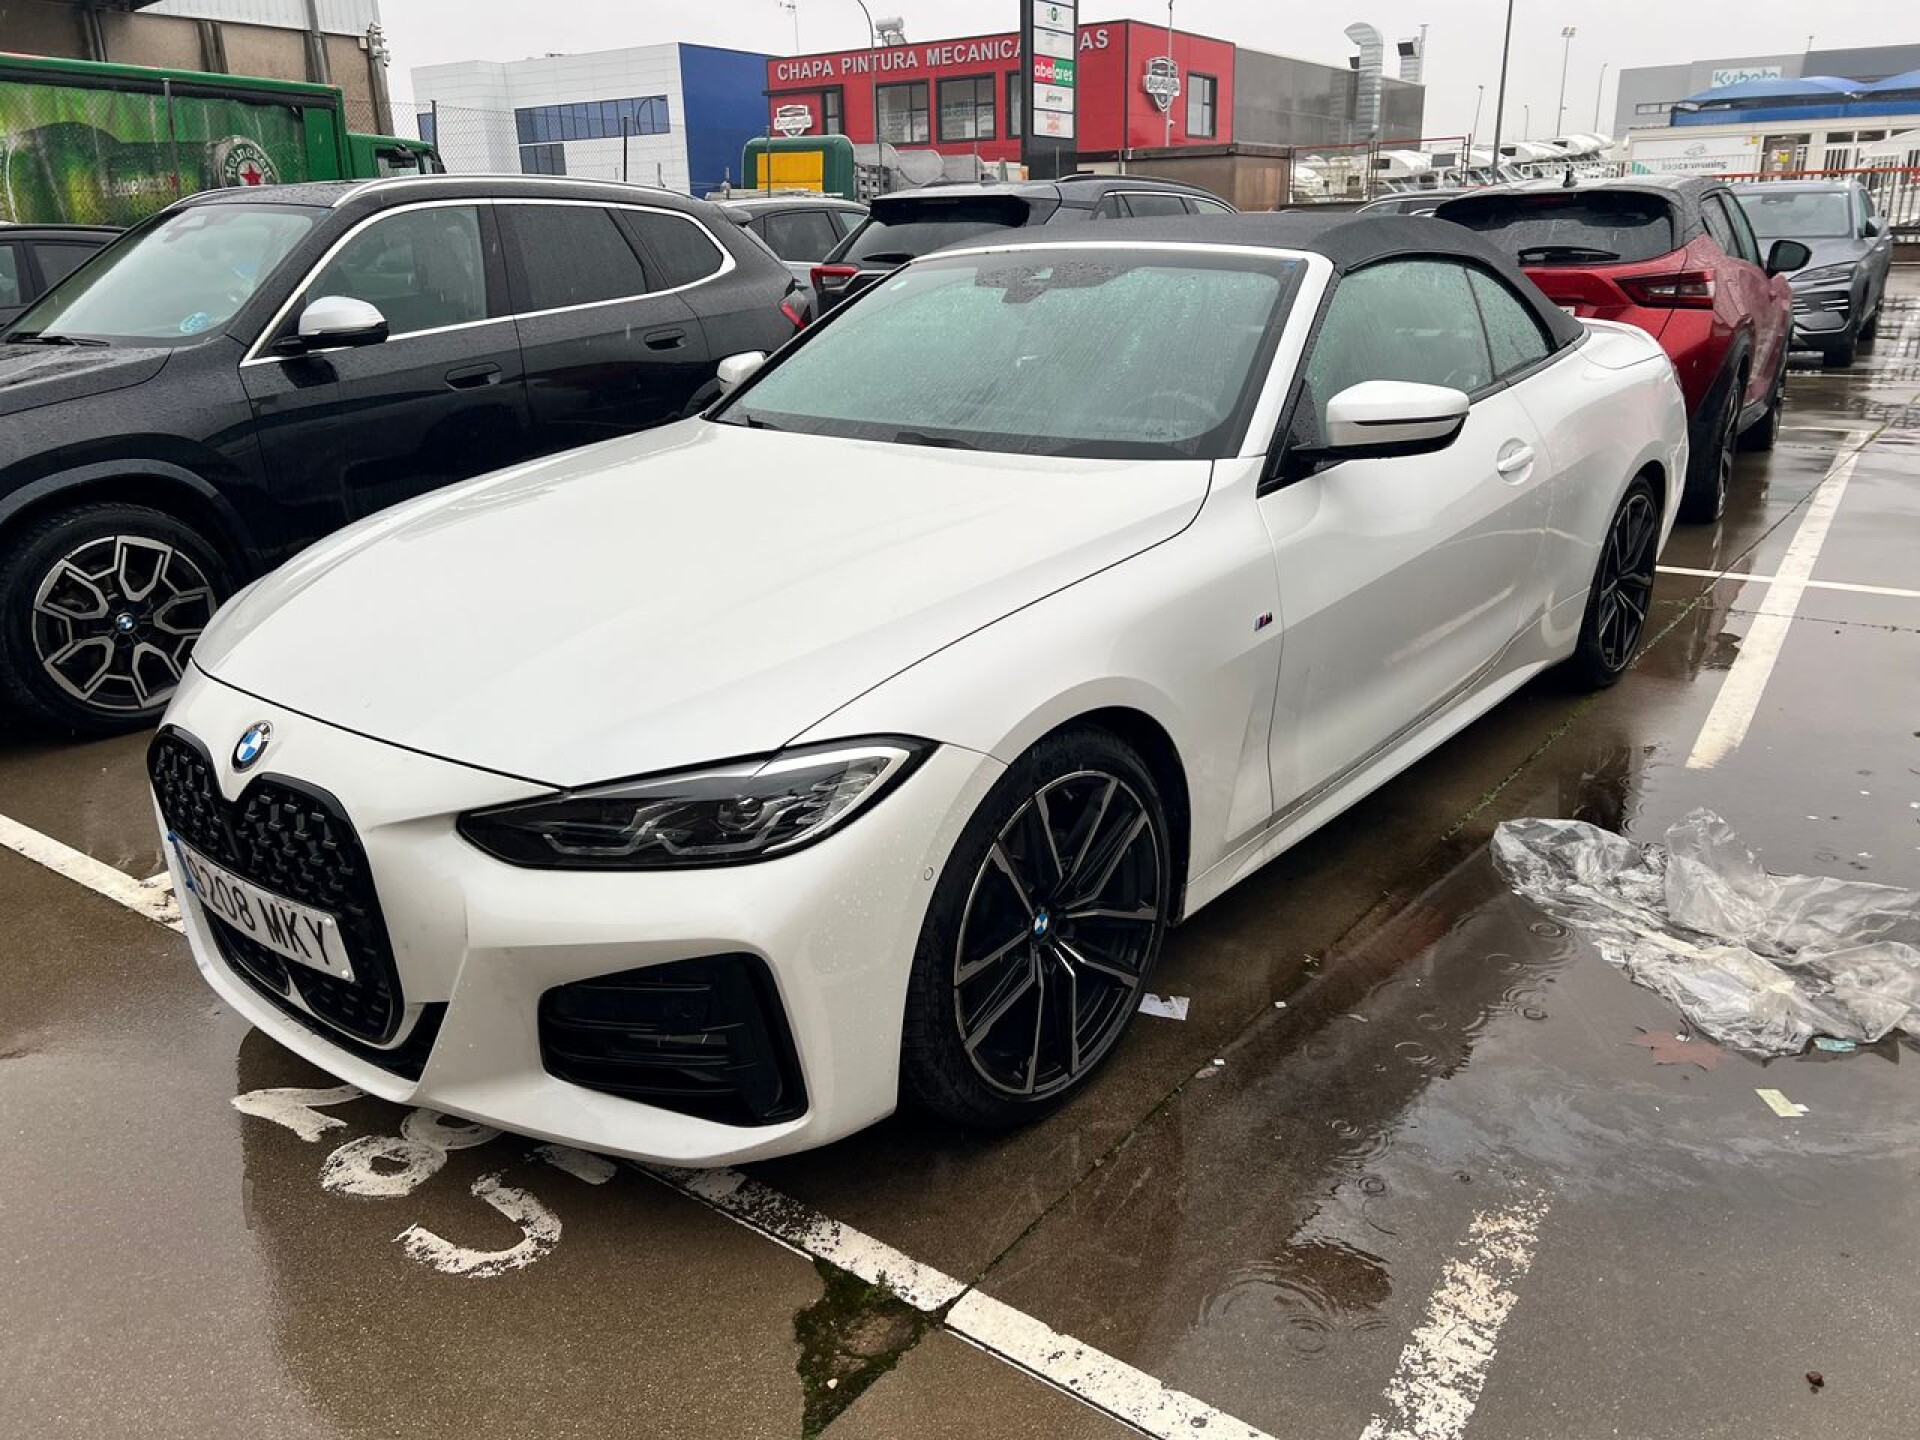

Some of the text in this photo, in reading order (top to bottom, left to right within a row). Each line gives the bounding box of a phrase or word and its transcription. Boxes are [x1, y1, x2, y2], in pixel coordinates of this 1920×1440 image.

[778, 60, 834, 80] CHAPA
[841, 51, 919, 75] PINTURA
[186, 854, 330, 966] 9208 MKY
